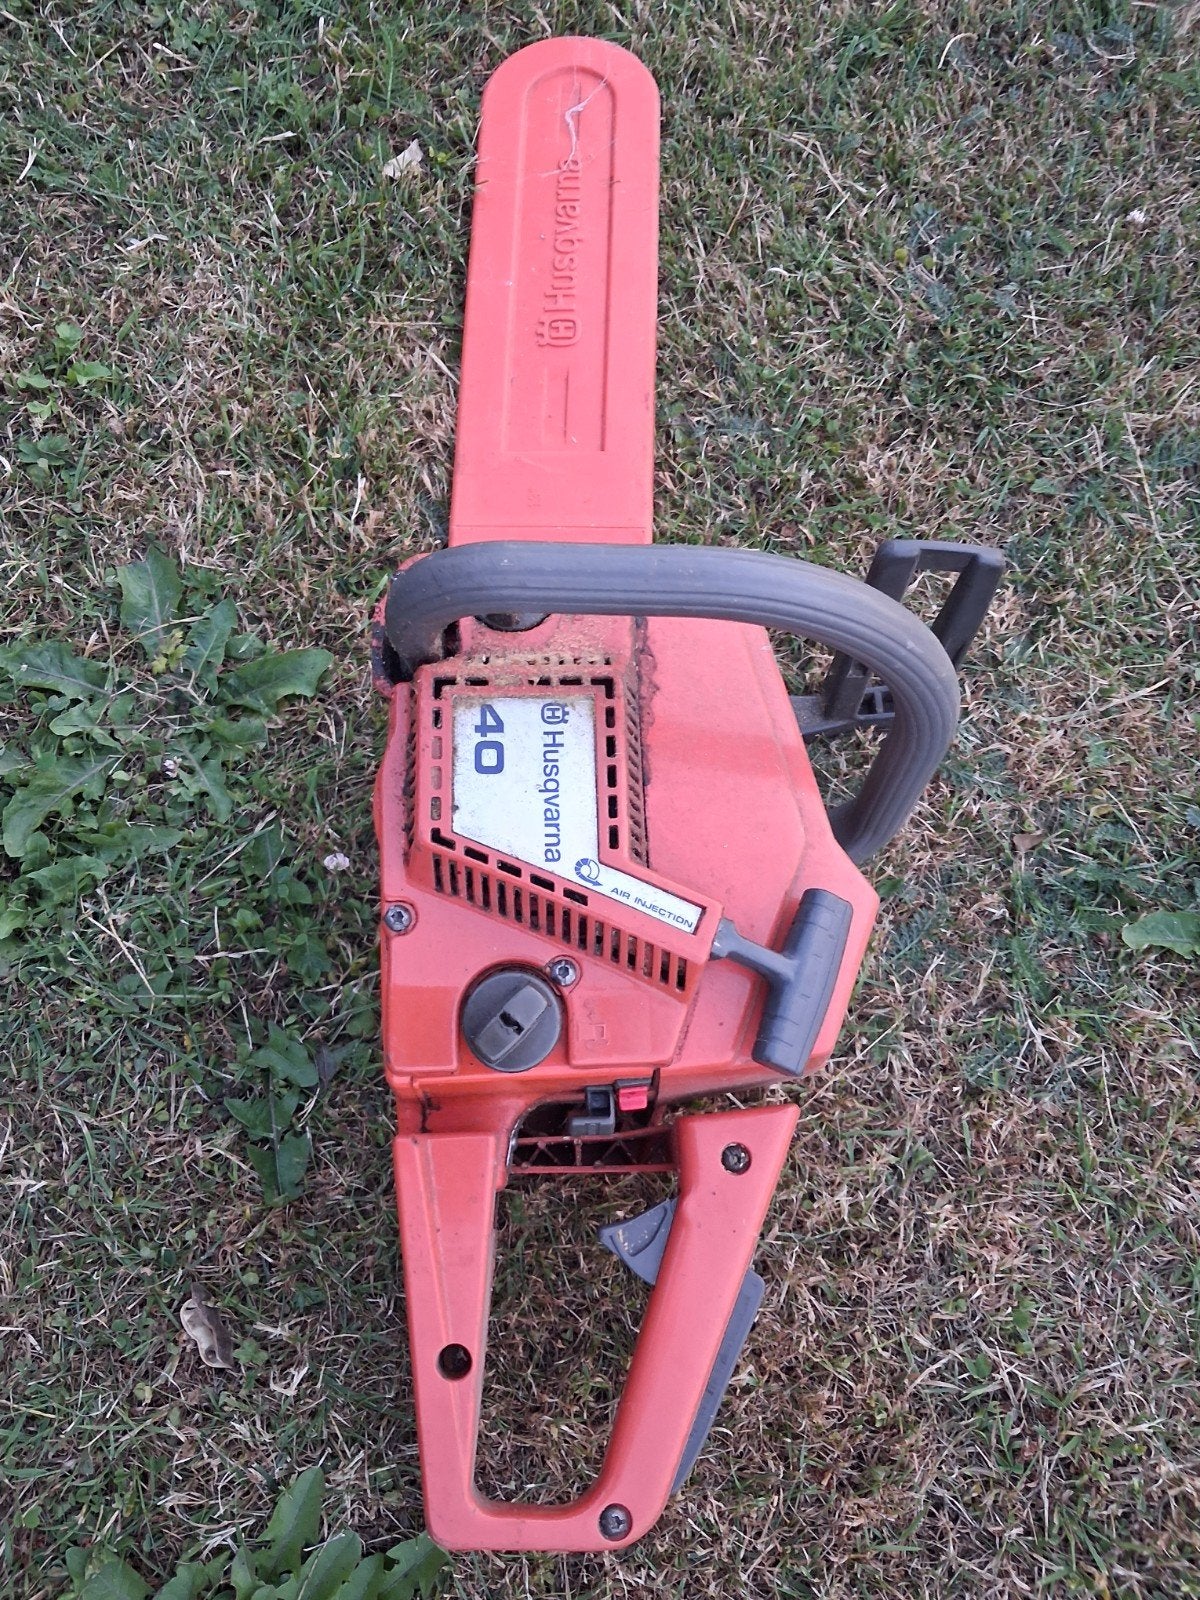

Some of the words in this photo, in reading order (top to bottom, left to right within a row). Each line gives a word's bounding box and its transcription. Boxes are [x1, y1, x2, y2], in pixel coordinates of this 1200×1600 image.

[543, 159, 582, 313] Husqvarna
[474, 703, 505, 775] 40
[538, 730, 565, 863] Husqvarna
[610, 887, 631, 900] AIR
[633, 896, 694, 929] INJECTION
